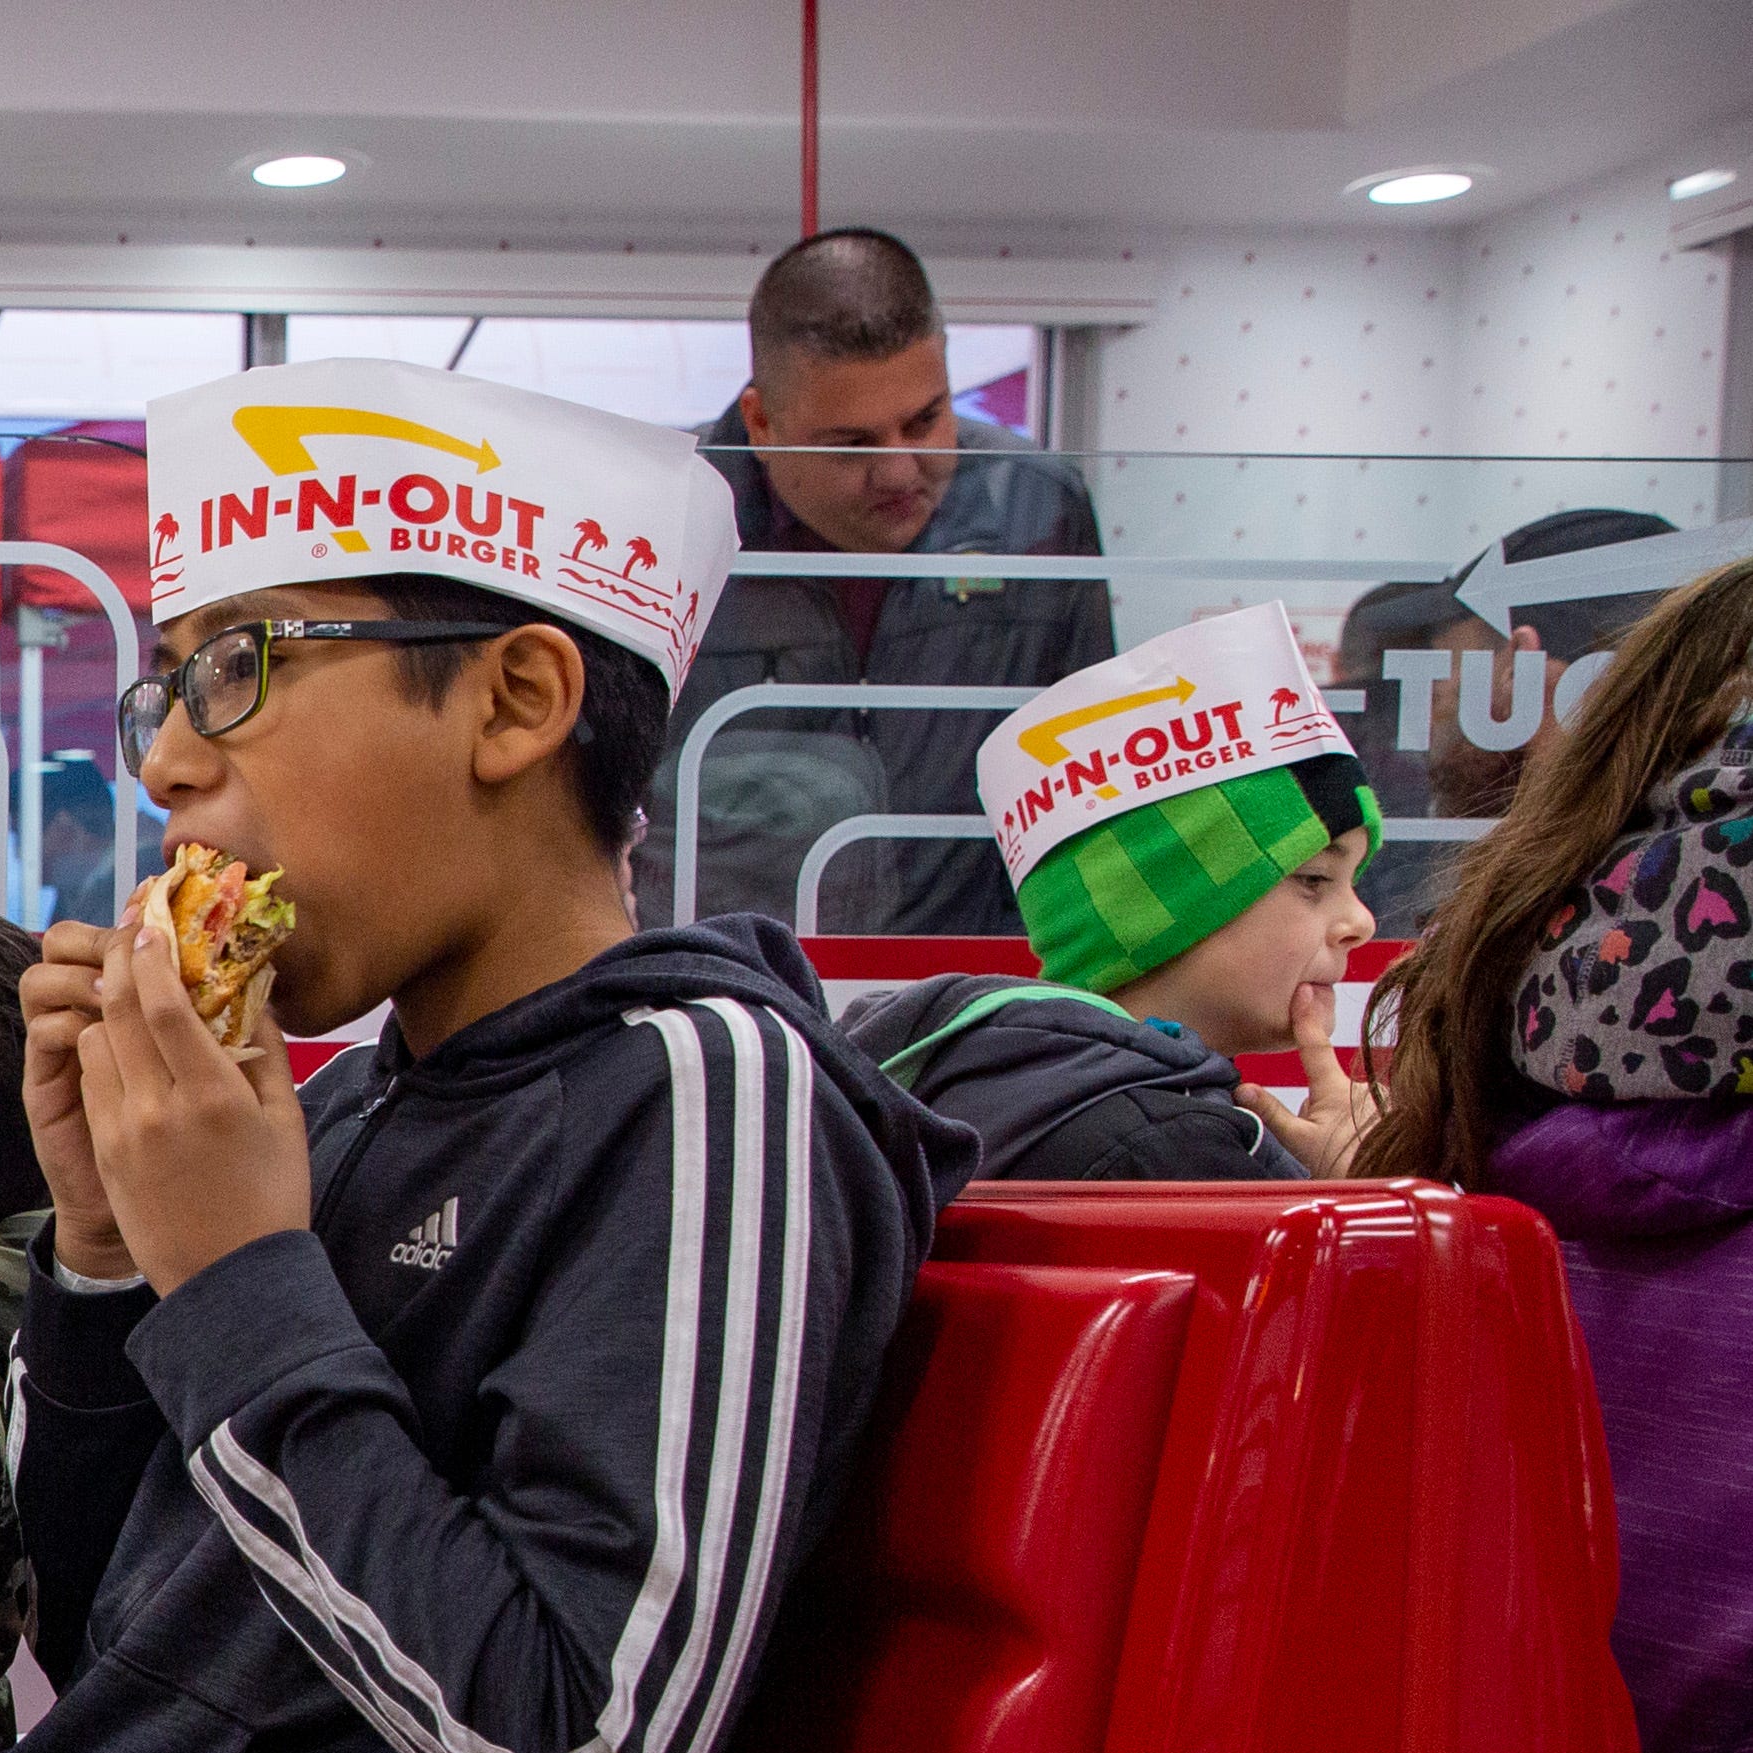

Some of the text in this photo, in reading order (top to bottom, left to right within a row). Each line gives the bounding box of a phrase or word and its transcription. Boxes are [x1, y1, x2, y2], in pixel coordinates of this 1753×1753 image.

[200, 473, 545, 553] IN-N-OUT
[389, 527, 542, 580] BURGER
[1016, 701, 1243, 833] IN-N-OUT
[1133, 740, 1257, 790] BURGER
